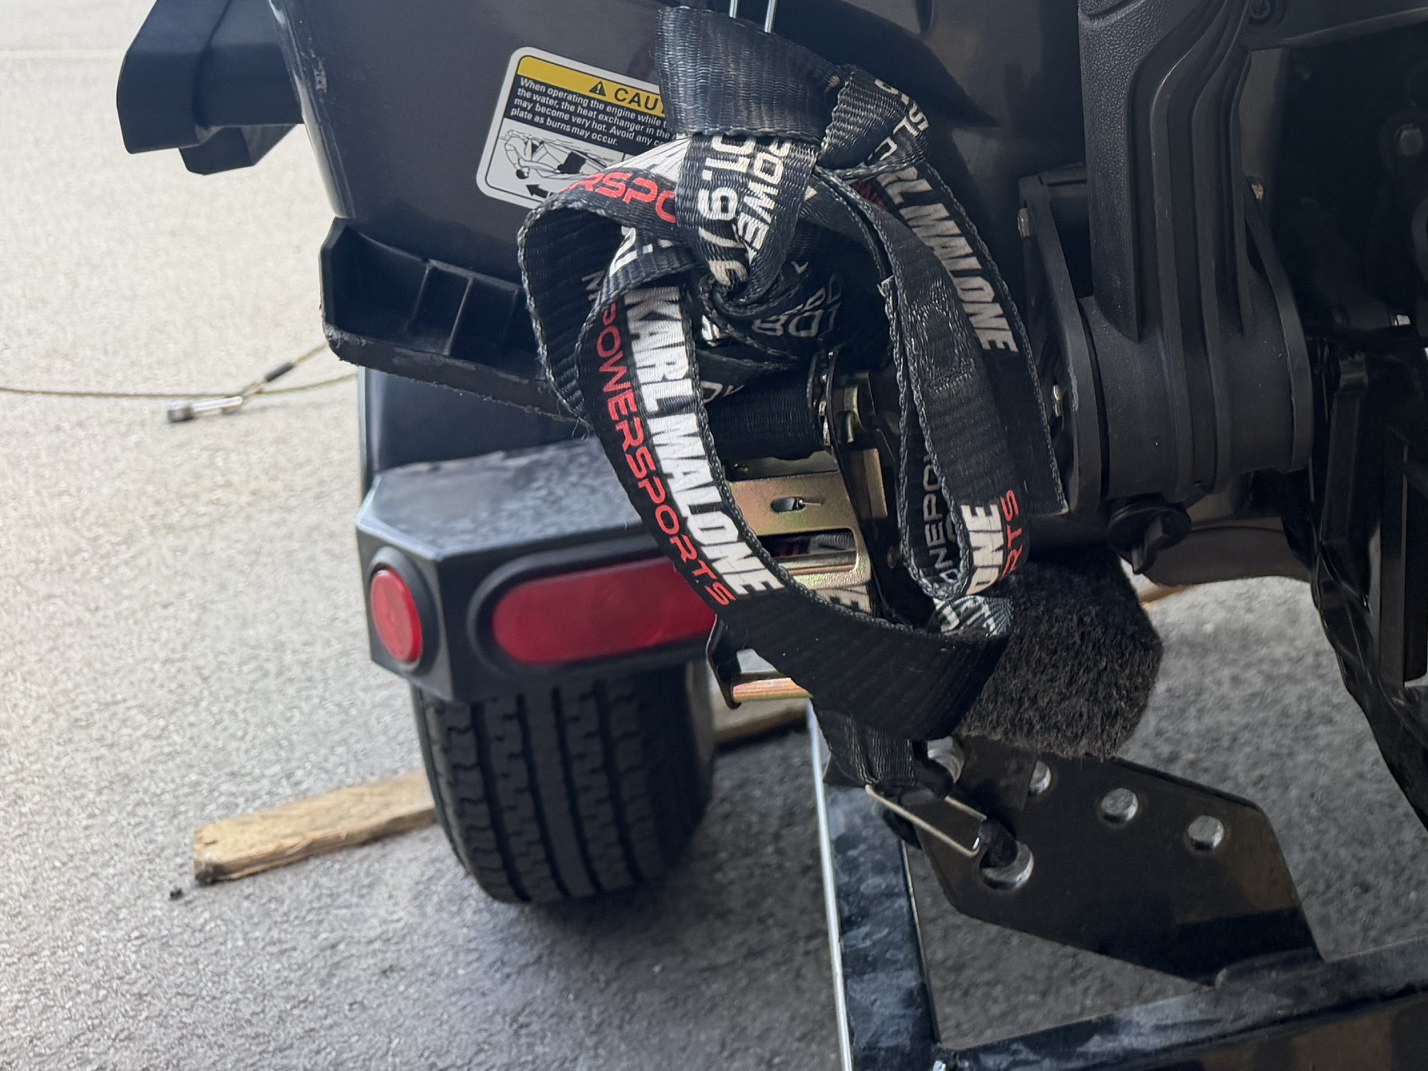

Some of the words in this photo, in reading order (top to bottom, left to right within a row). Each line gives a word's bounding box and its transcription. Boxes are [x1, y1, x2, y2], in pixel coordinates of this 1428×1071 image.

[514, 97, 533, 111] may
[535, 104, 570, 122] become
[571, 115, 591, 129] very
[592, 118, 608, 131] hot.
[609, 126, 635, 140] Avoid
[635, 133, 653, 147] any
[517, 87, 531, 99] the
[532, 92, 560, 109] water,
[561, 100, 576, 114] the
[577, 105, 597, 119] heat
[598, 112, 645, 132] exchanger
[646, 124, 655, 134] in
[655, 127, 671, 139] the
[520, 77, 546, 93] When
[547, 84, 589, 108] operating
[590, 97, 605, 111] the
[606, 102, 636, 120] engine
[637, 110, 662, 127] while
[614, 87, 664, 113] CAU
[510, 106, 533, 121] plate
[534, 115, 545, 123] as
[546, 117, 571, 132] burns
[570, 125, 591, 139] may
[591, 132, 619, 146] occur.
[624, 285, 695, 413] KARL
[646, 412, 786, 597] MALONE
